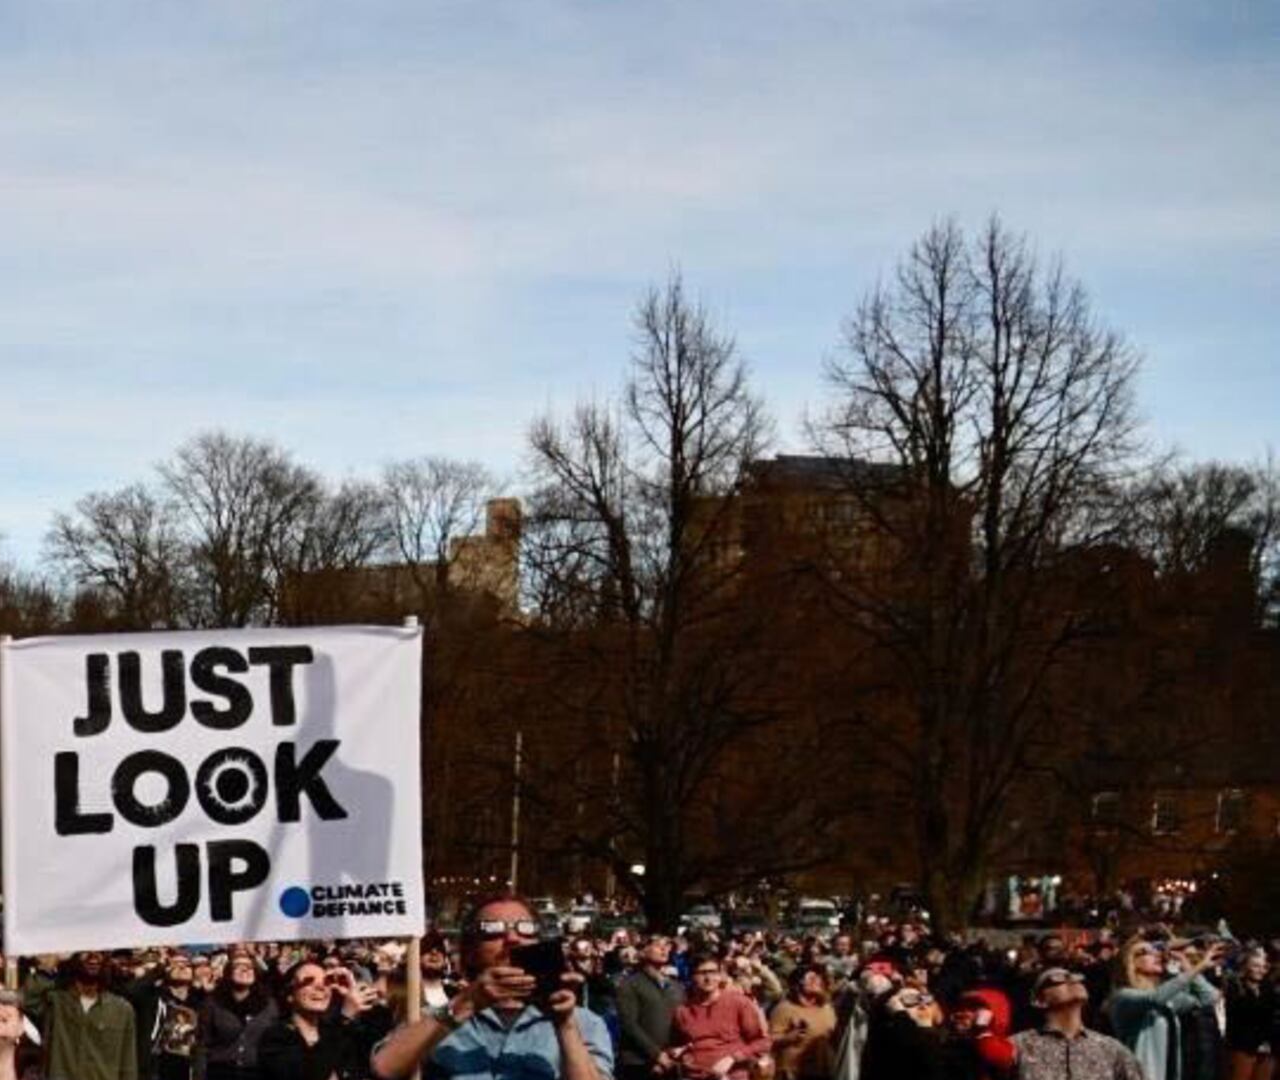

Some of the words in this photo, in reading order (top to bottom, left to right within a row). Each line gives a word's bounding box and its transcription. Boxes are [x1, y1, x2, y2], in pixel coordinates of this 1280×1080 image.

[74, 645, 314, 737] JUST
[55, 739, 348, 836] LOOK
[133, 840, 271, 927] UP
[310, 884, 402, 900] CLIMATE
[312, 900, 405, 918] DEFIANCE
